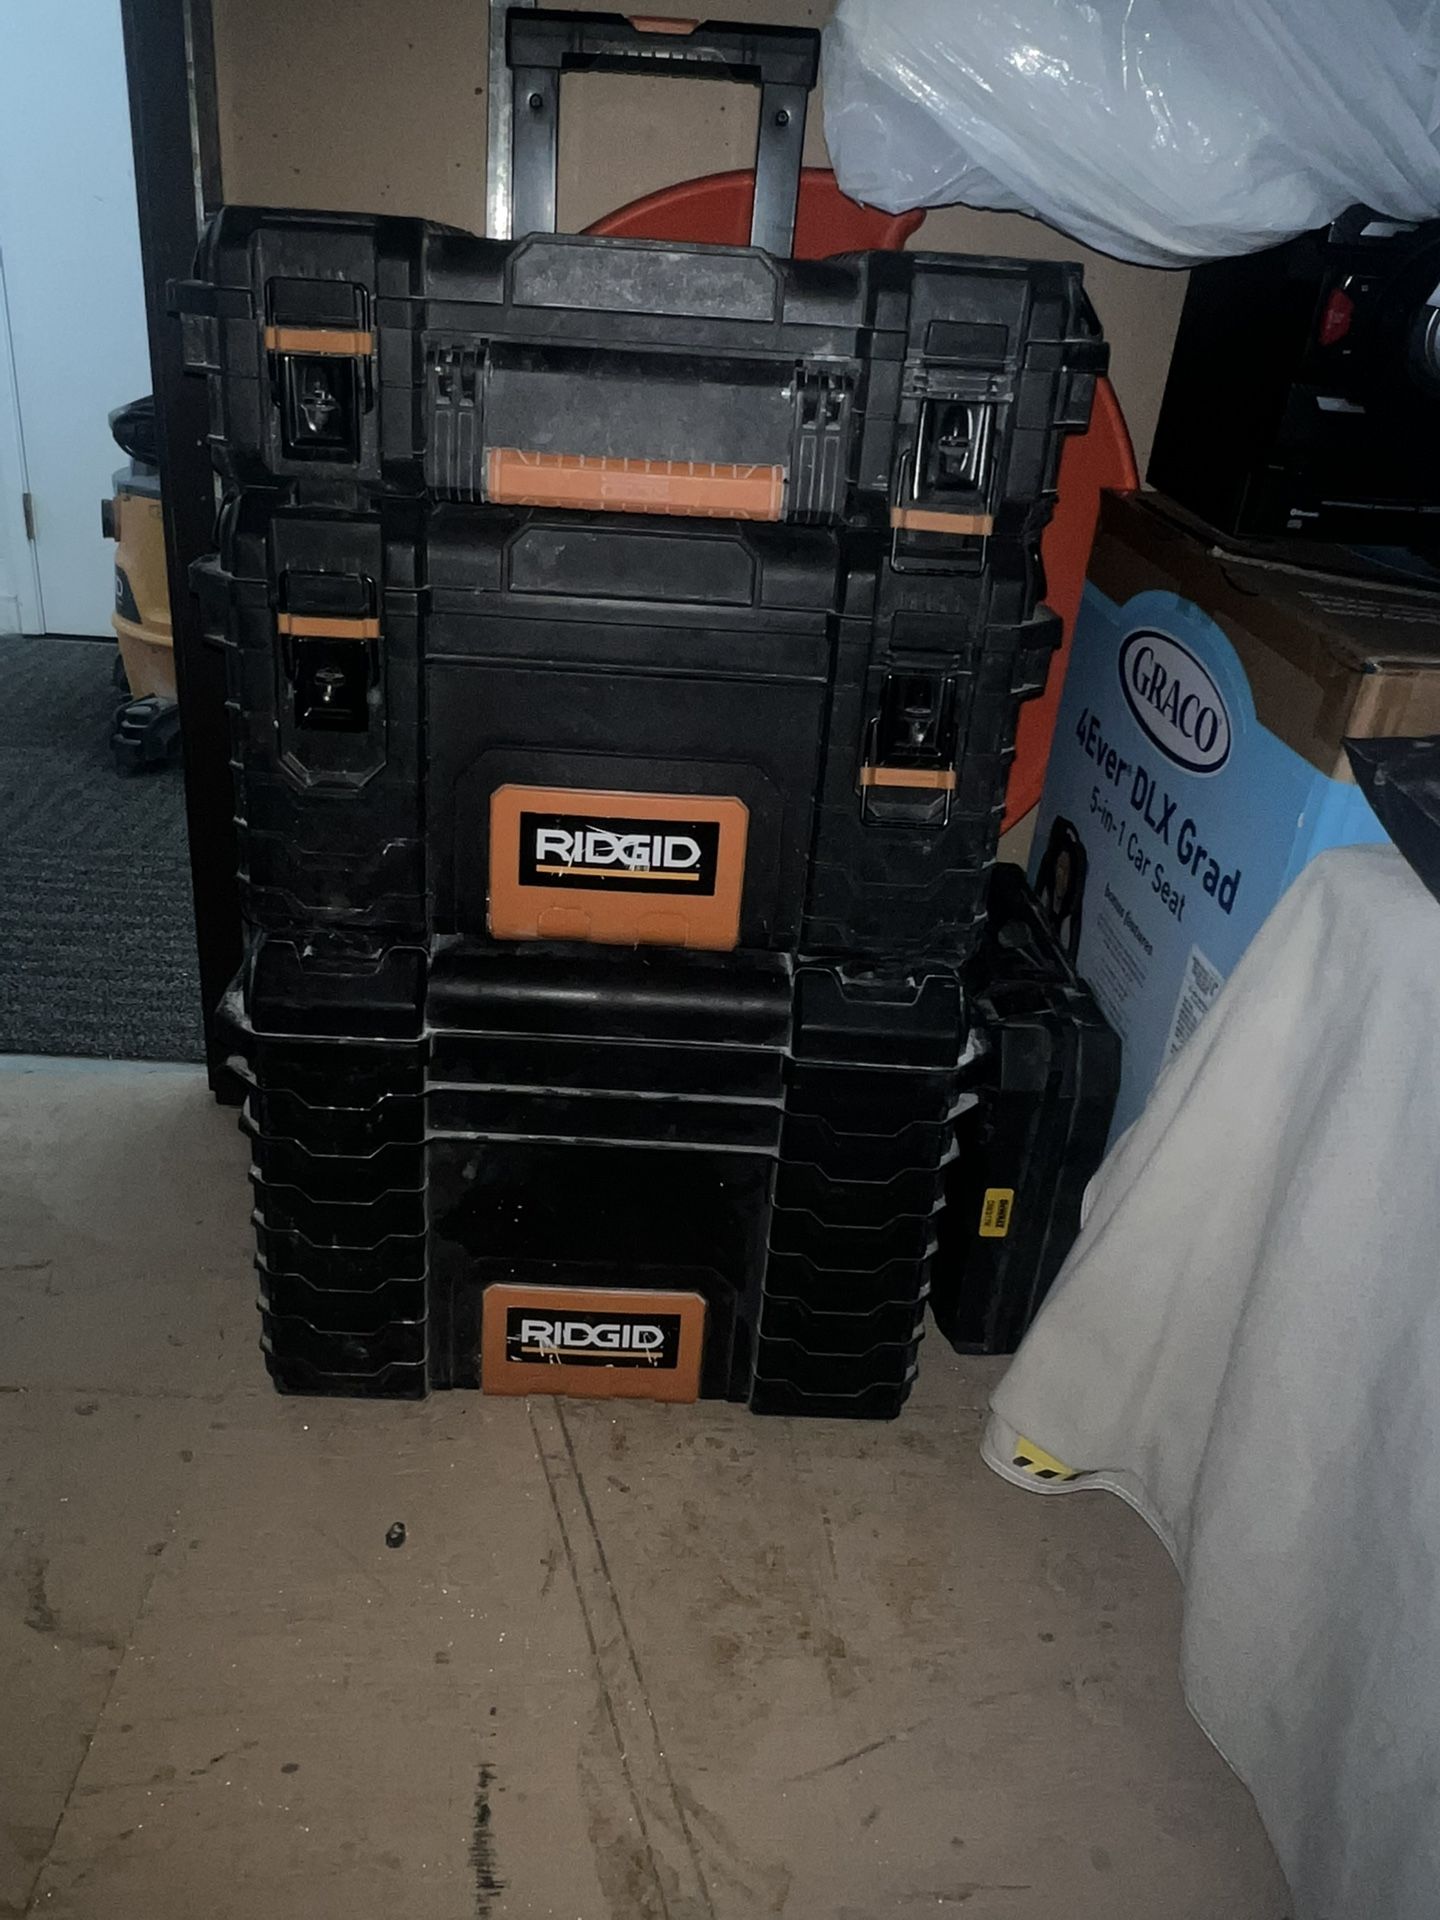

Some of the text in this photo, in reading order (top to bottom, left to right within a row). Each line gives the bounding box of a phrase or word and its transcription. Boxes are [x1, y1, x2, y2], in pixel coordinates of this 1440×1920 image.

[1132, 646, 1219, 753] GRACO
[535, 827, 702, 868] RIDGID
[1075, 707, 1128, 787] 4Ever
[1130, 766, 1177, 846] DLX
[1177, 818, 1242, 915] Grad
[1090, 786, 1186, 923] 5-in-1 Car Seat
[520, 1318, 665, 1350] RIDGID
